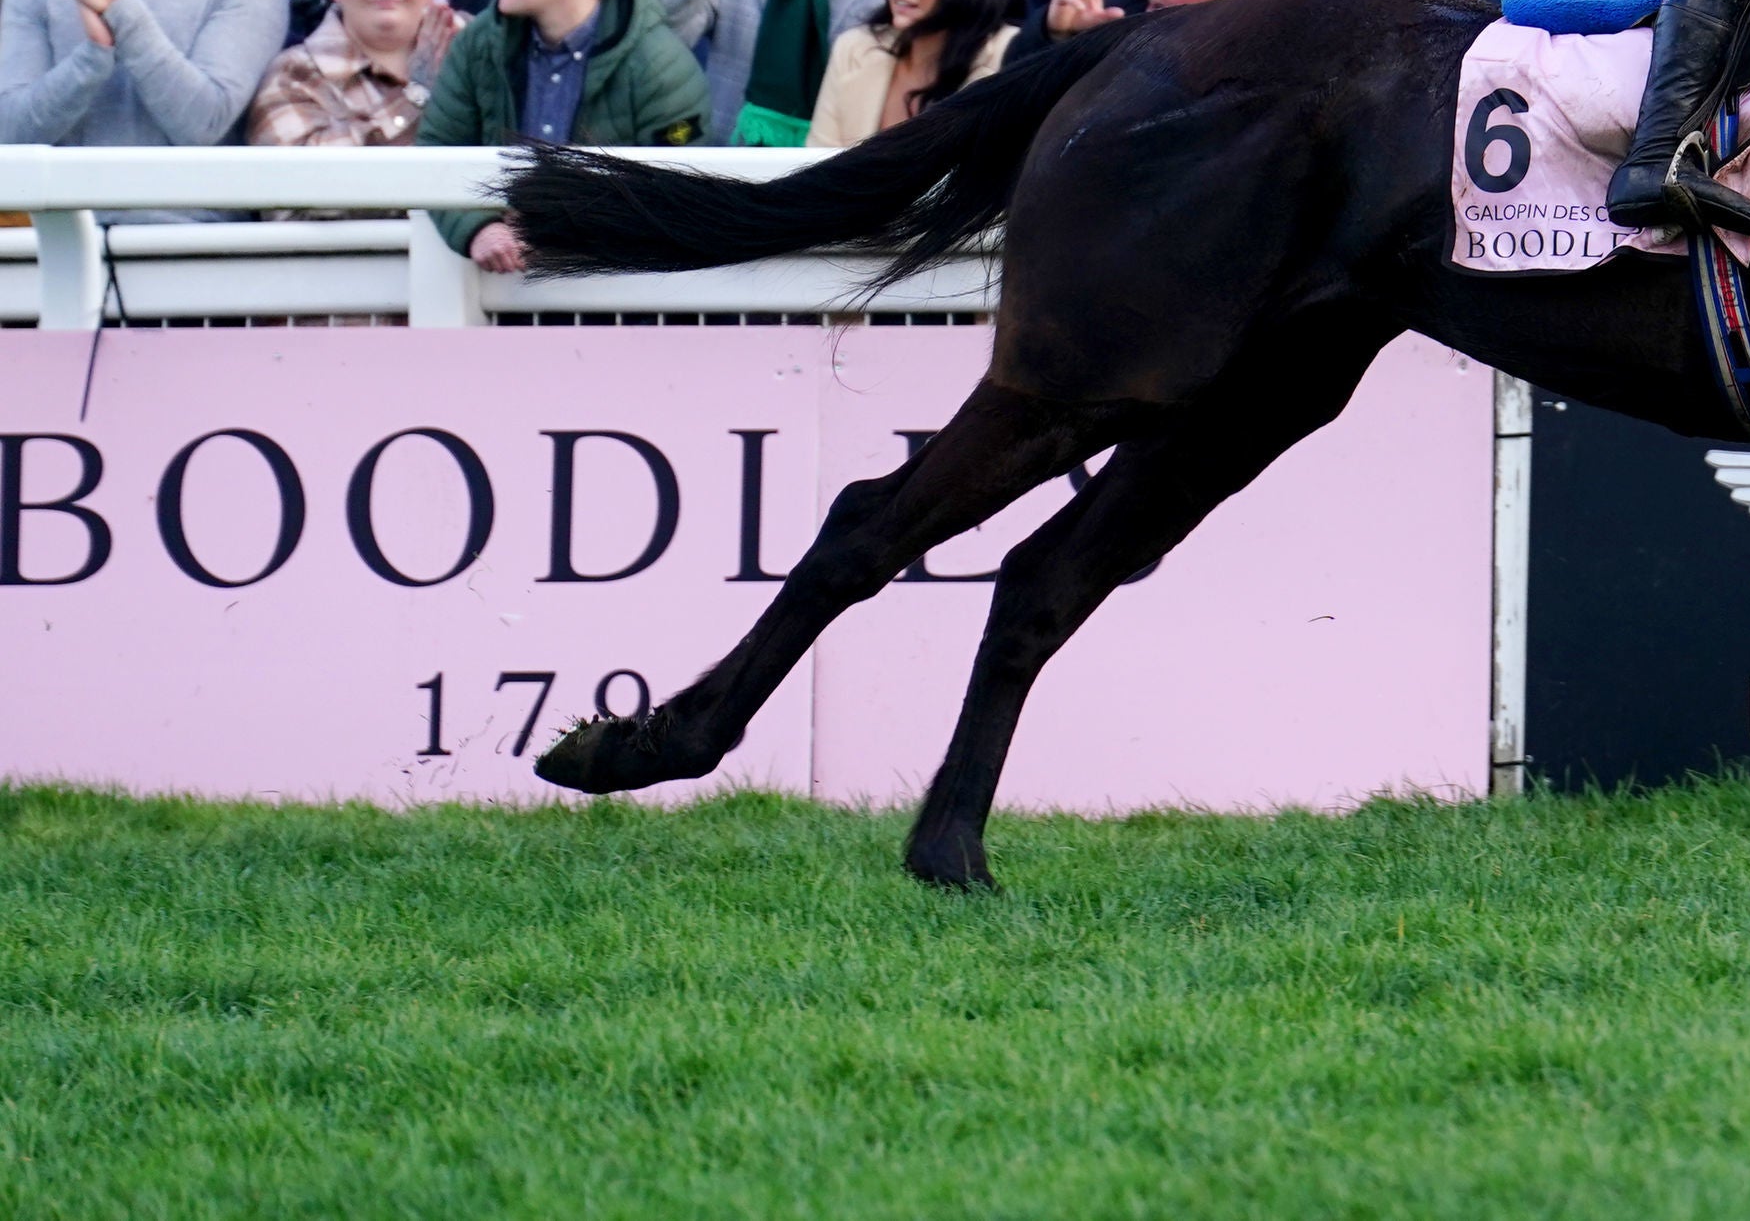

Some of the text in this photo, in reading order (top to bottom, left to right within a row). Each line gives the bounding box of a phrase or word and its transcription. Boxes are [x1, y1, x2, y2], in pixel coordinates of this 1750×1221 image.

[1464, 87, 1531, 193] 6
[1464, 203, 1548, 222] GALOPIN
[1553, 204, 1590, 222] DES
